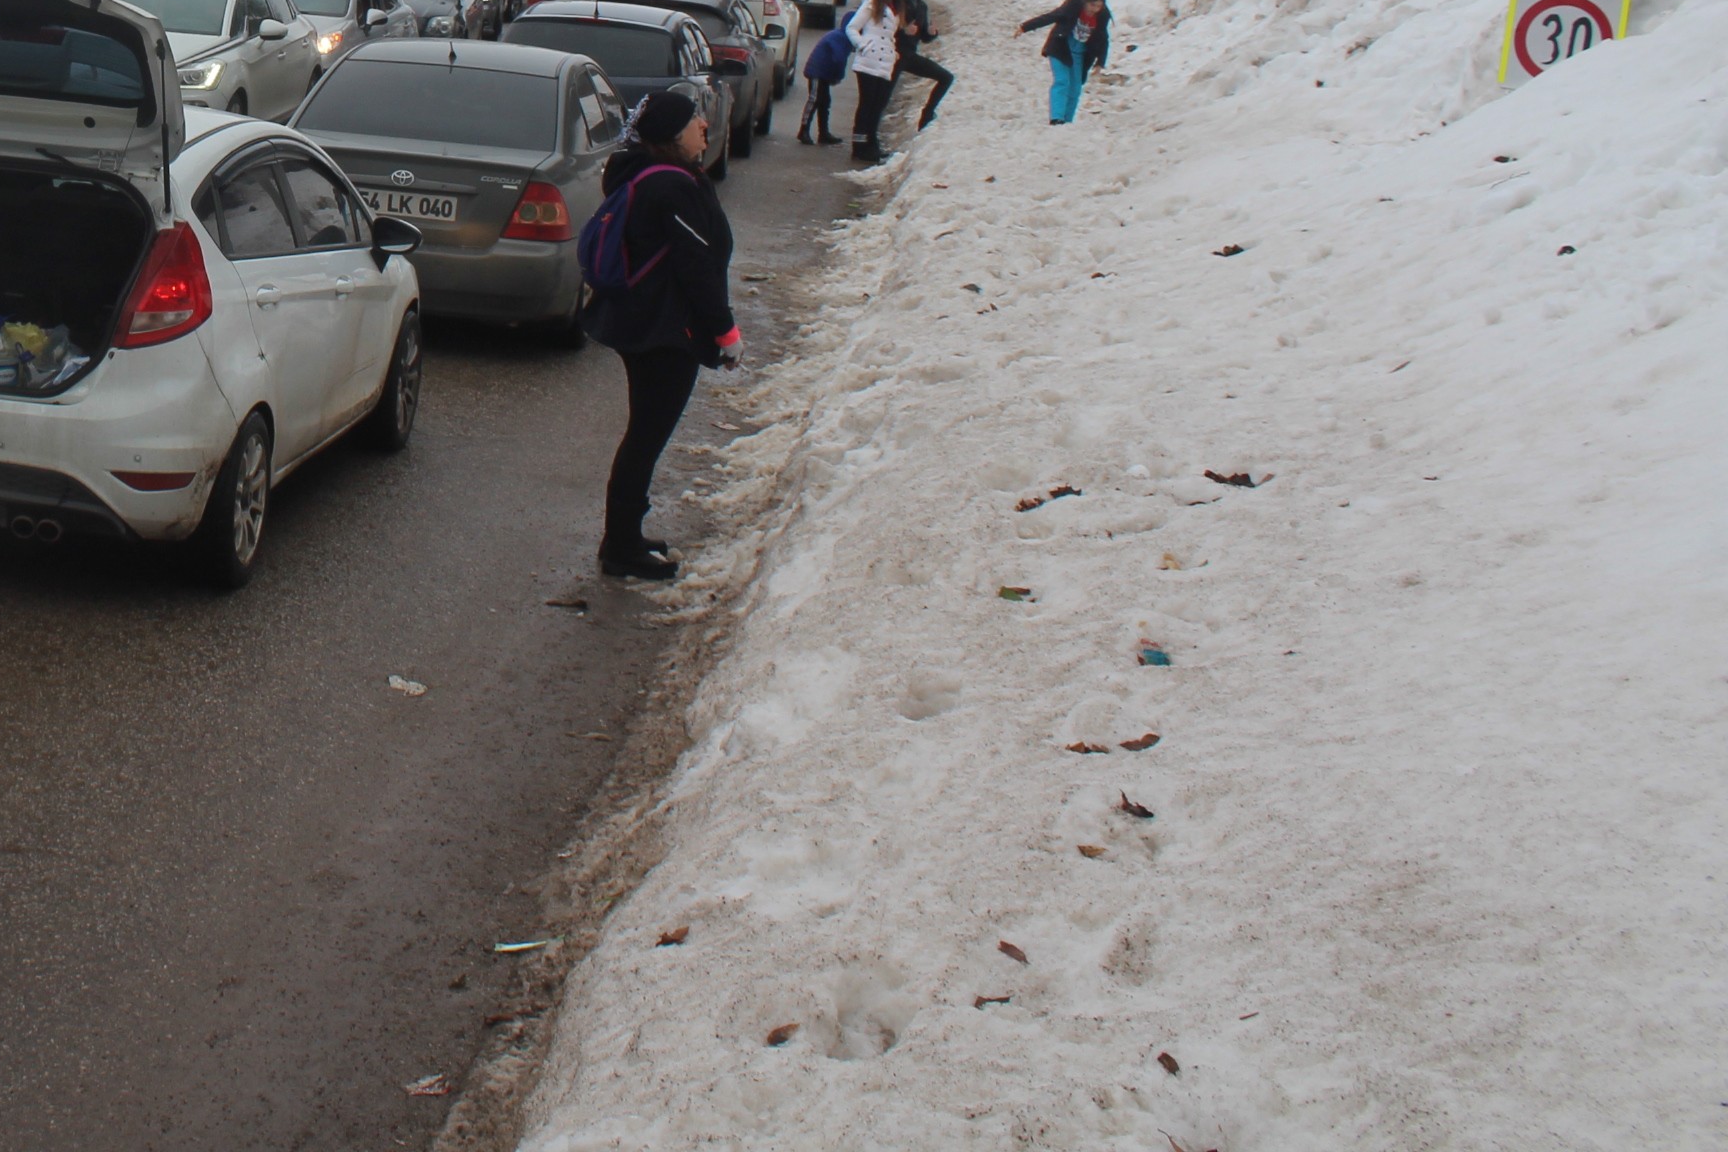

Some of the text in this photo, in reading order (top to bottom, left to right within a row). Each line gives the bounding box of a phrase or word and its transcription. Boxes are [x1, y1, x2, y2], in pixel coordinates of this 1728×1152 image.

[1541, 13, 1592, 65] 30
[387, 193, 413, 215] LK
[419, 197, 453, 218] 040
